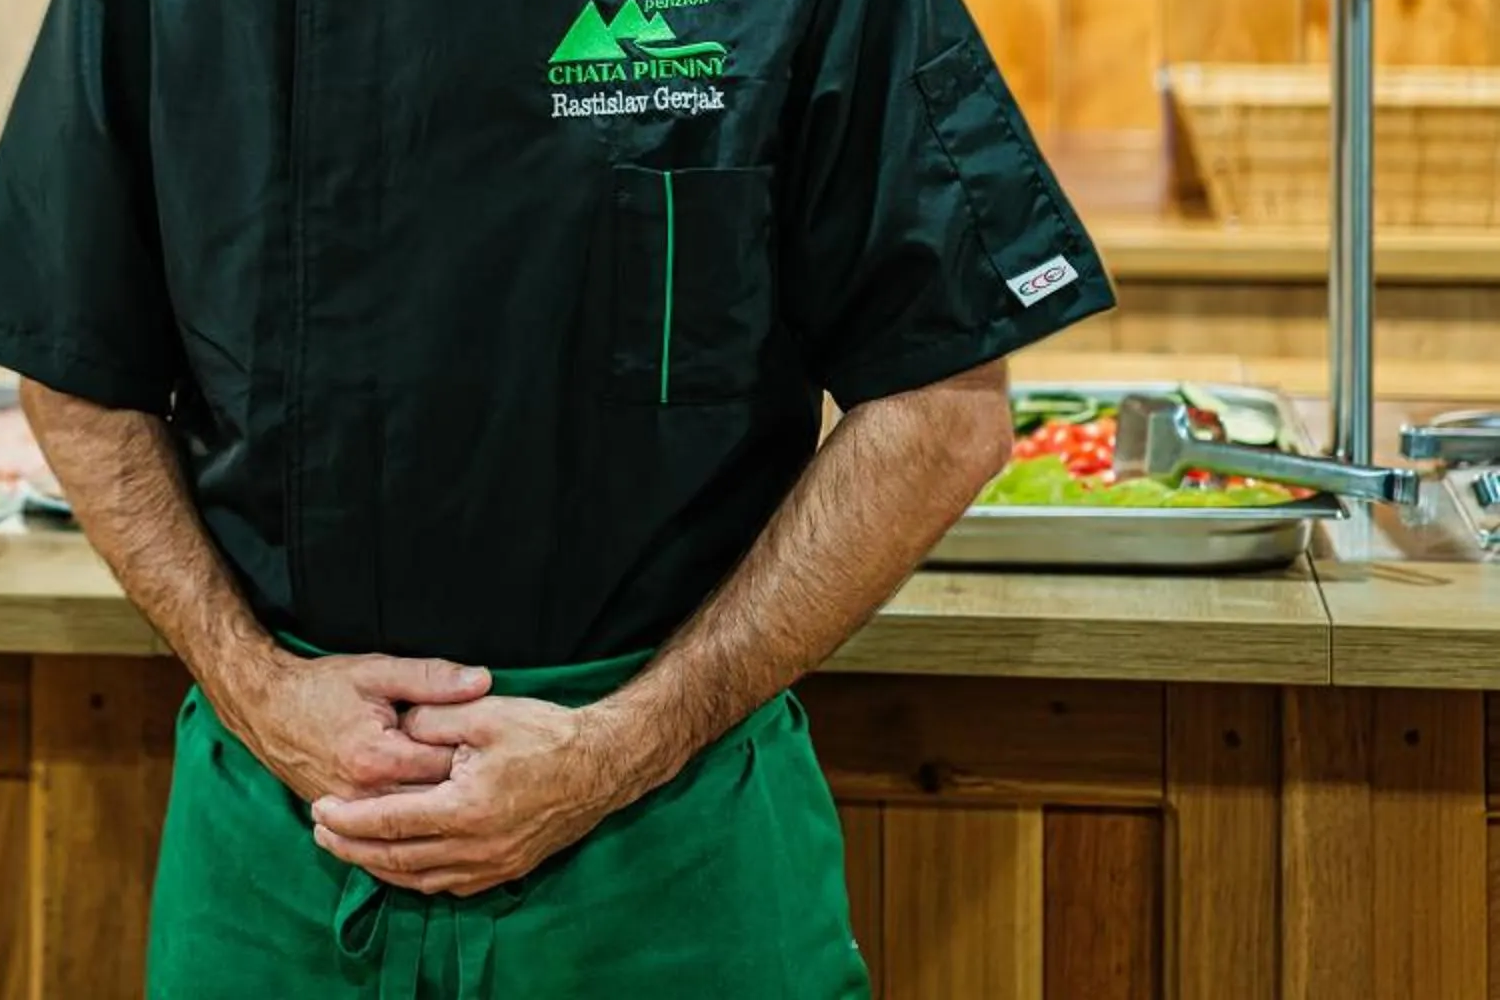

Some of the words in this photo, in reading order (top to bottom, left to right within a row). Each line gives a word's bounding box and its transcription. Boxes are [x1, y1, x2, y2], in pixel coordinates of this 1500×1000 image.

[549, 63, 626, 85] CHATA
[634, 56, 727, 80] PIENINY
[552, 90, 649, 118] Rastislav
[654, 85, 725, 115] Gerjak
